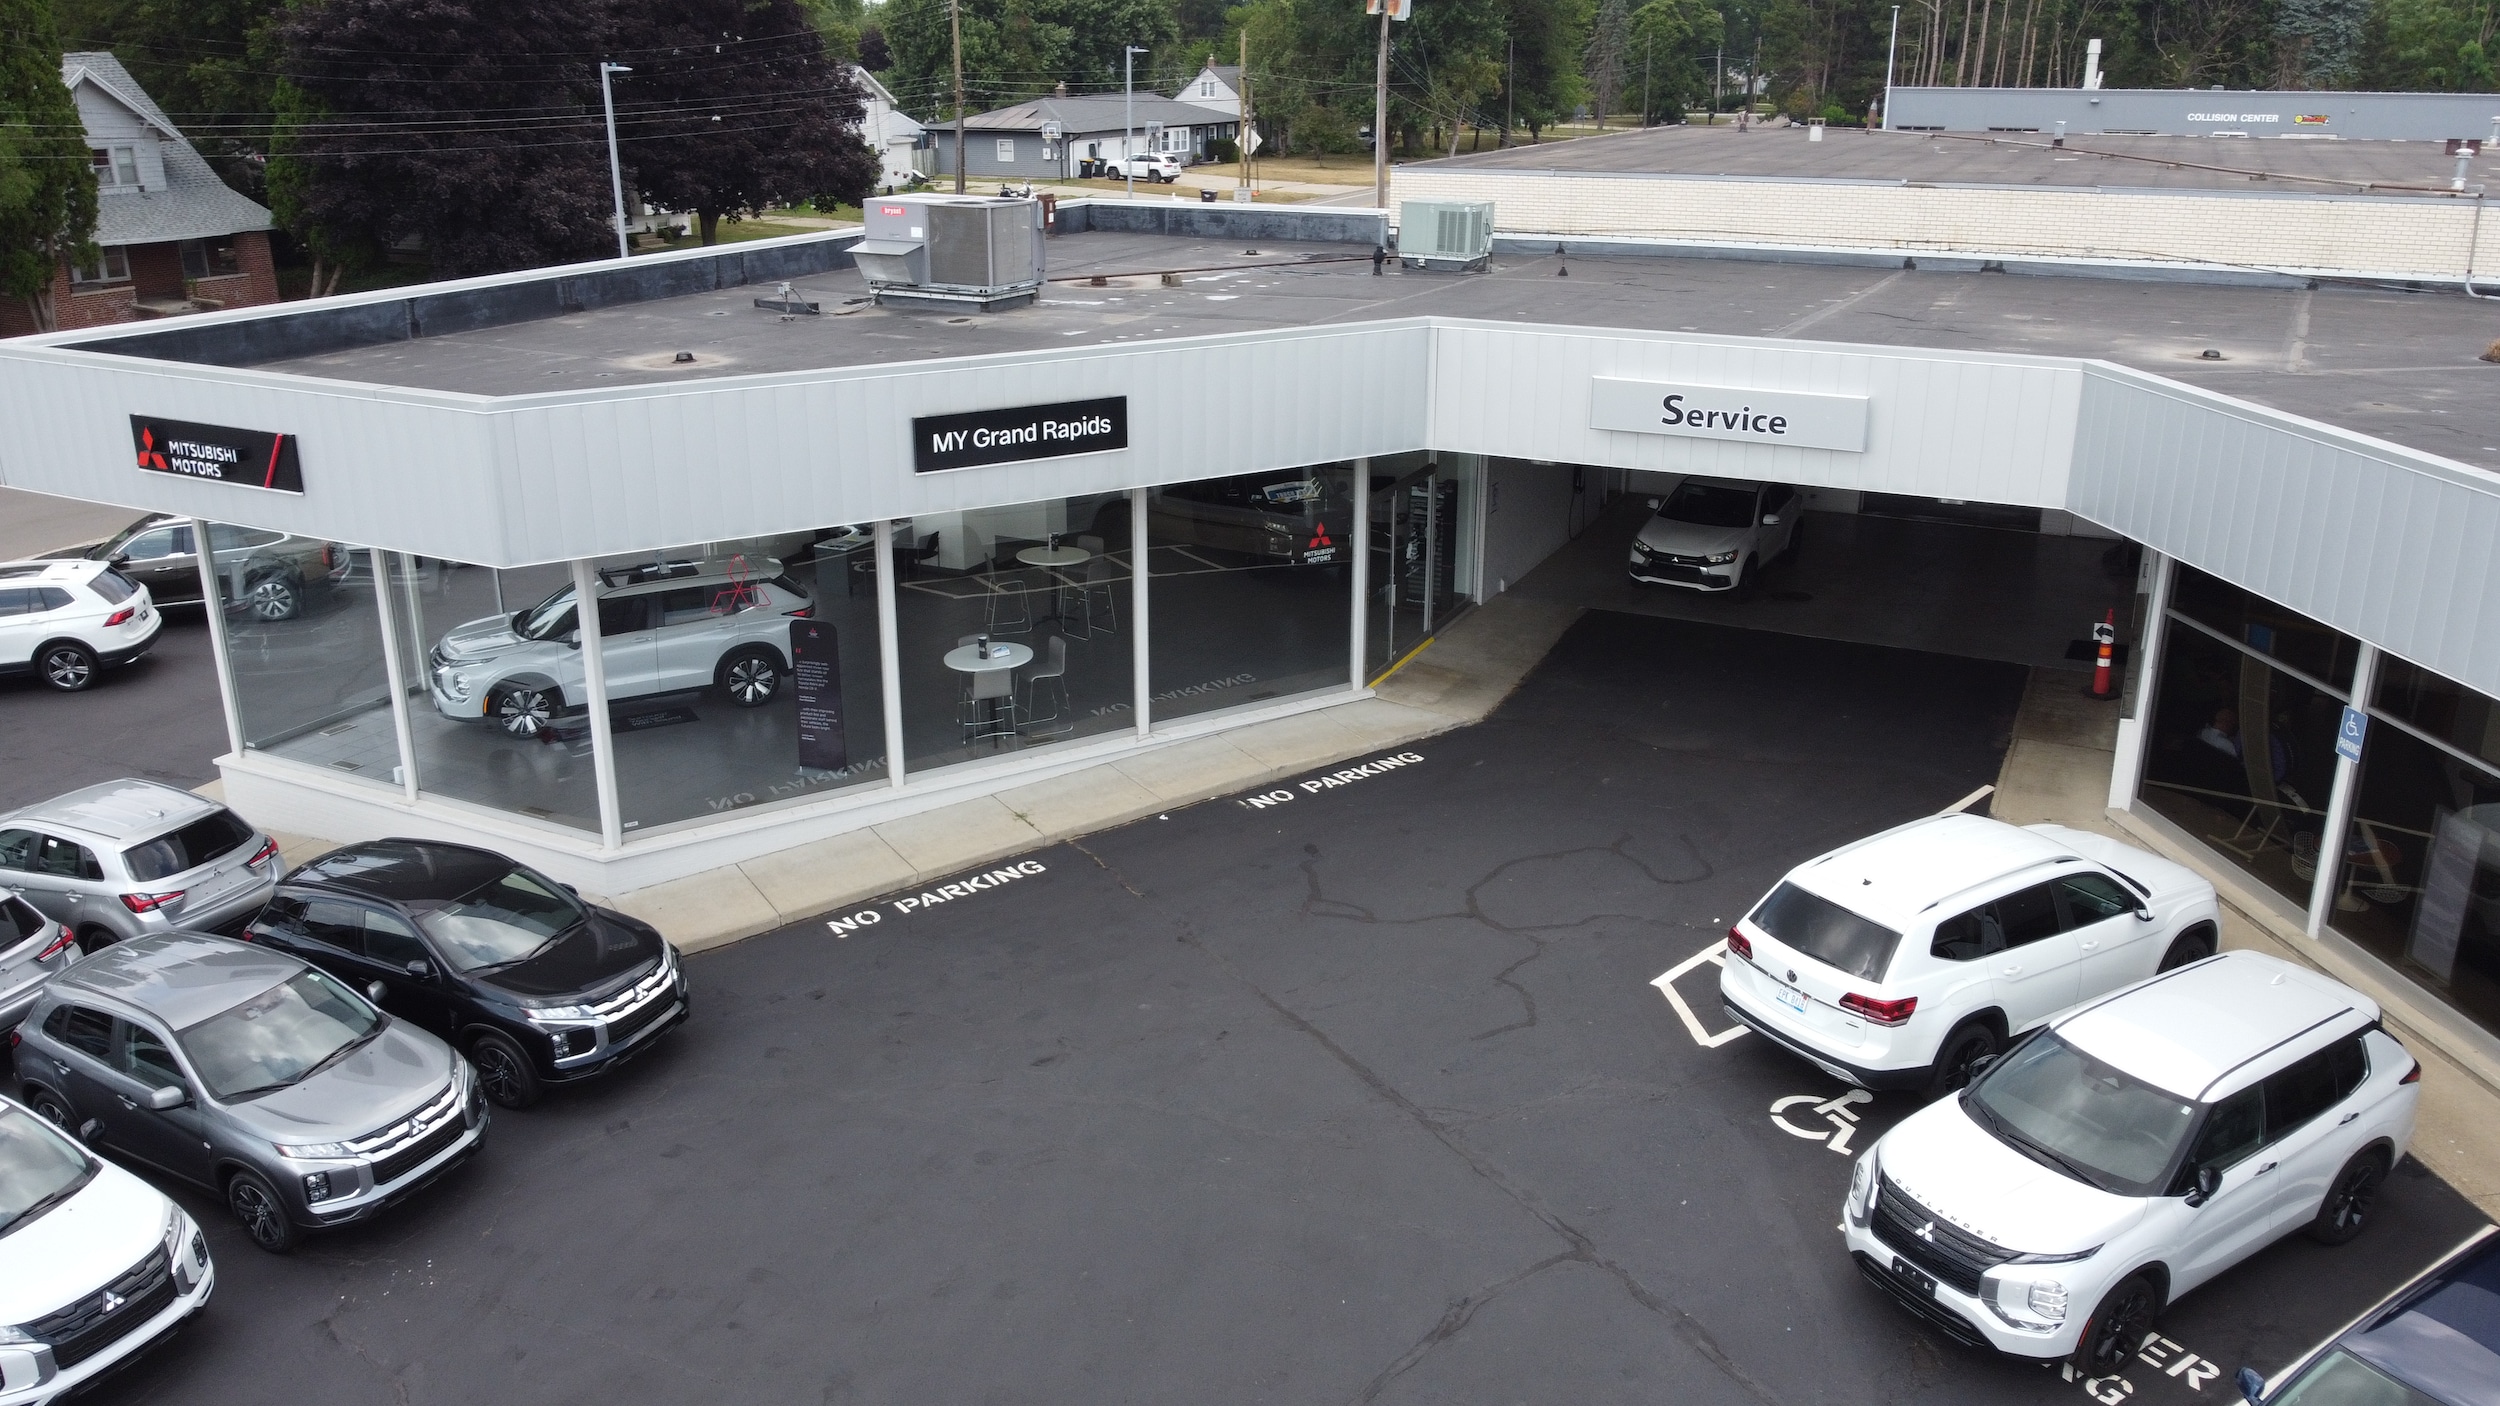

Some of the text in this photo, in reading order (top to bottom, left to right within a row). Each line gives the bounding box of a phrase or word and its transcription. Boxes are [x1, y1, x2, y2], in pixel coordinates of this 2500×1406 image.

[2187, 113, 2279, 122] COLLISION CENTER
[1661, 394, 1787, 435] Service
[932, 415, 1111, 453] MY Grand Rapids
[168, 440, 238, 463] MITSUBISHI
[171, 457, 222, 478] MOTORS
[1303, 547, 1336, 558] MITSUBISHI
[1307, 554, 1332, 564] MOTORS
[2339, 737, 2361, 756] PARKING
[1246, 751, 1425, 809] NO PARKING
[826, 860, 1047, 939] NO PARKING
[1895, 1178, 1999, 1243] OUTLANDER
